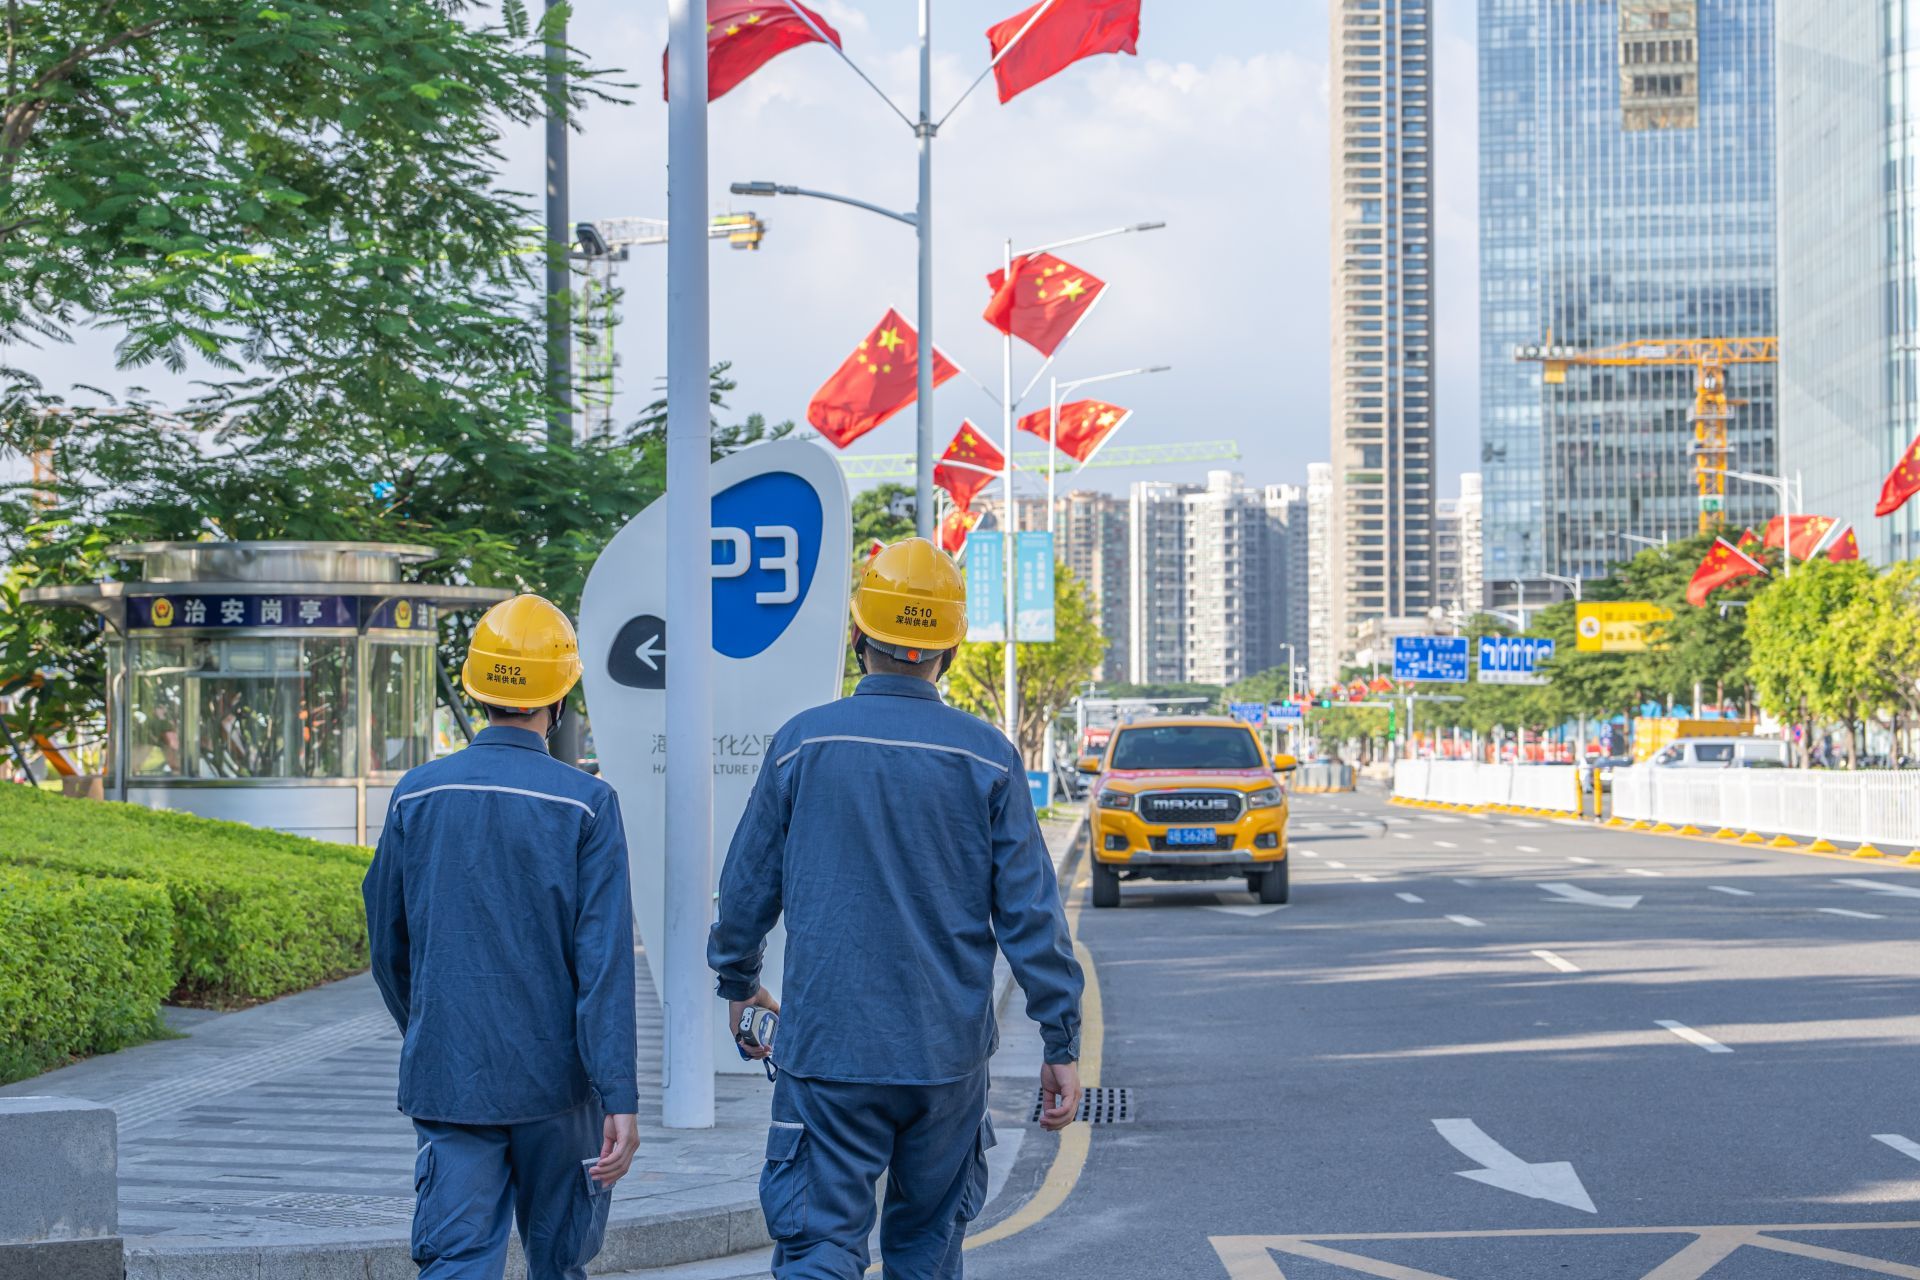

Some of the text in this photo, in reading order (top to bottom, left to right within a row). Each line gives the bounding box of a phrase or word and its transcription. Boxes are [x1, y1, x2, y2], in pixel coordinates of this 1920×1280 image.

[711, 525, 800, 604] P3
[184, 599, 322, 624] 治安岗亭
[904, 605, 932, 618] 5510
[895, 614, 937, 628] 深圳供电局
[494, 663, 521, 676] 5512
[486, 672, 527, 686] 深圳供电局
[1153, 799, 1229, 810] MAXUS
